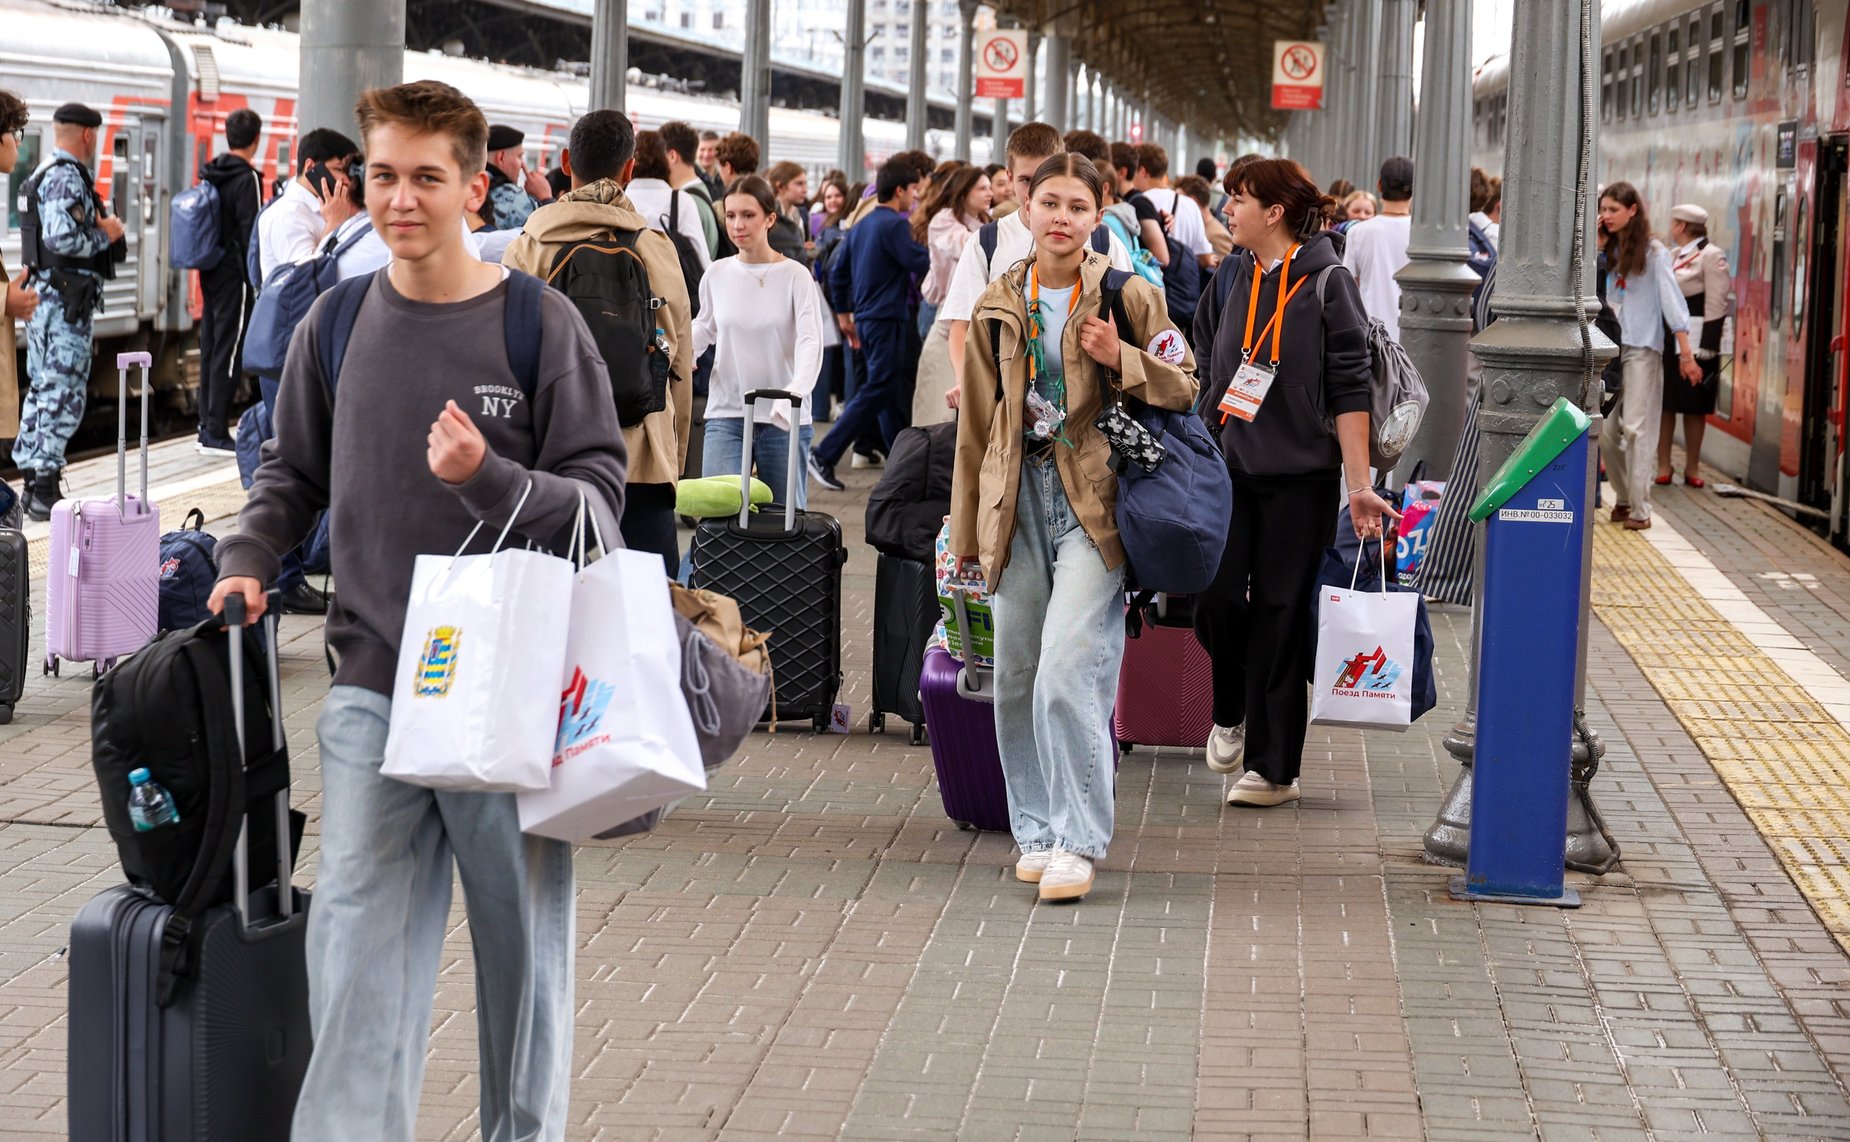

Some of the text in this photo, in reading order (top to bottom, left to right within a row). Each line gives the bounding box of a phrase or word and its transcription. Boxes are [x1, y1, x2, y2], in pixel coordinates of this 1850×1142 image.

[481, 396, 517, 418] NY
[1331, 688, 1396, 699] Поезд Памяти
[565, 734, 610, 759] Памяти
